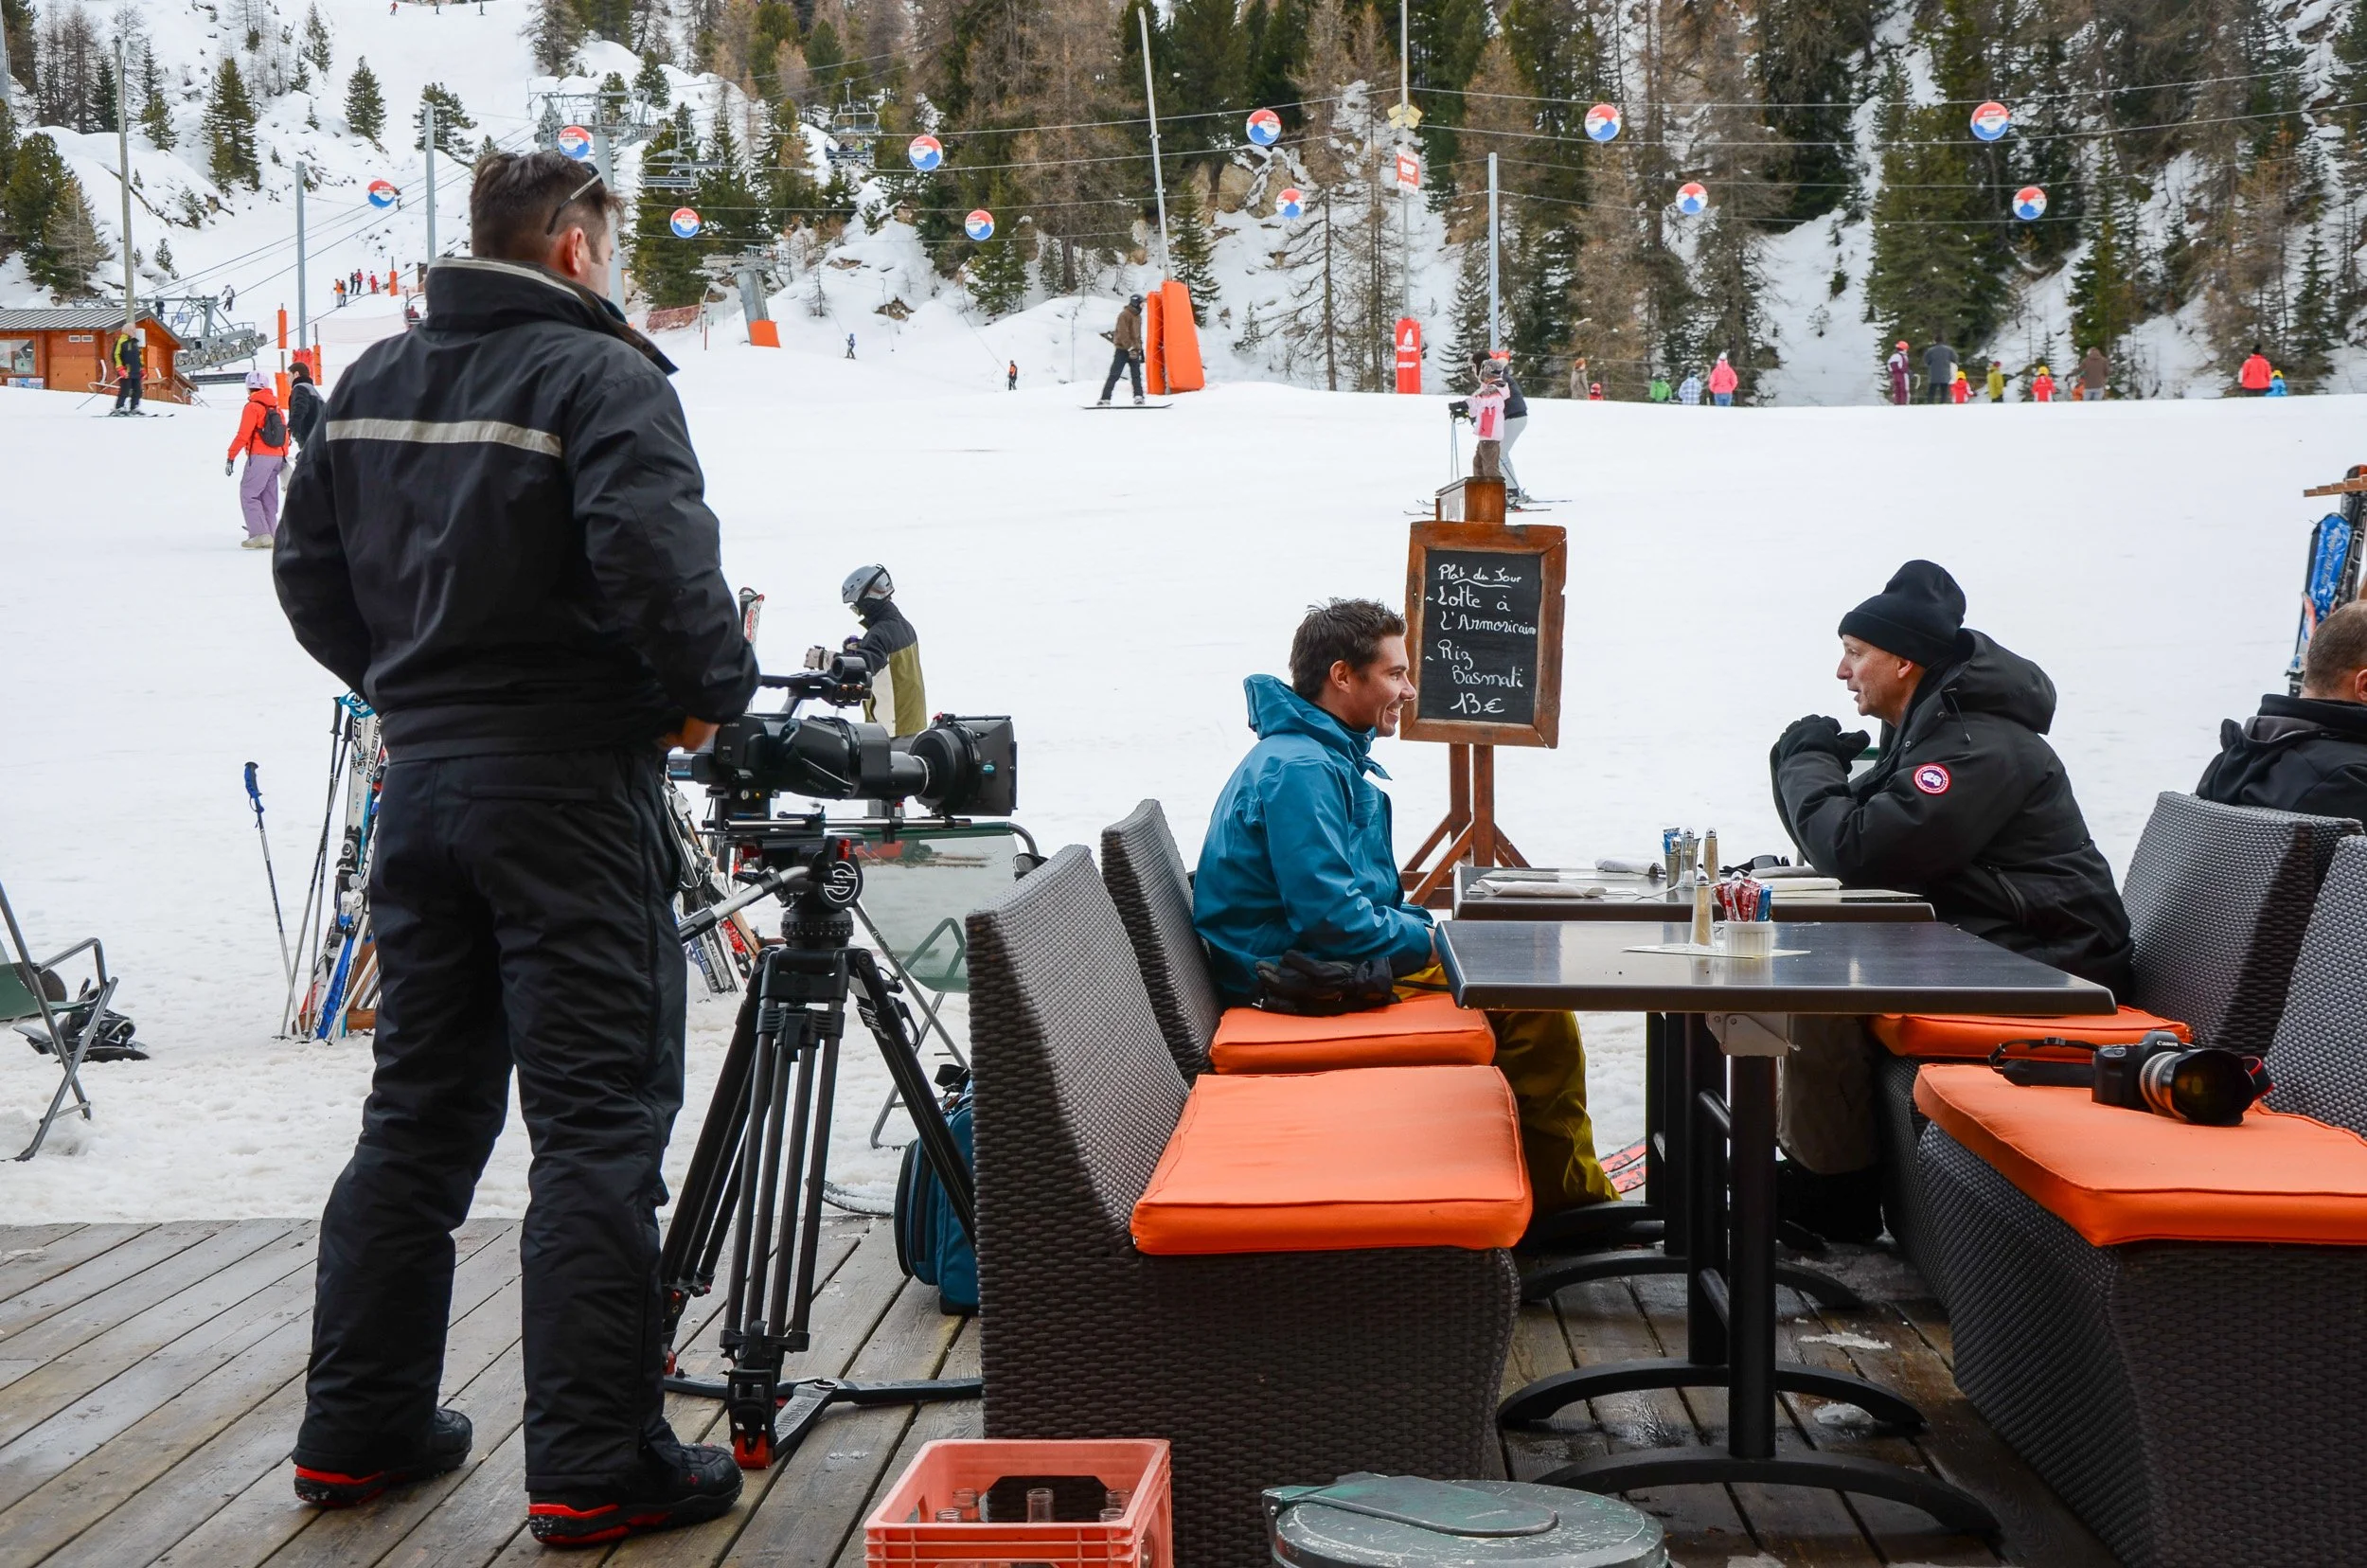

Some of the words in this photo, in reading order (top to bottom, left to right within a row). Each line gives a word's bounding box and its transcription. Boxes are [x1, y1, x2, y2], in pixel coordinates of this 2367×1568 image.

[1438, 563, 1465, 580] Plat
[1473, 567, 1489, 582] du
[1437, 586, 1481, 608] Lotte
[1497, 596, 1511, 611] à
[1437, 639, 1473, 670] Riz
[1452, 666, 1523, 687] Basmati
[1450, 692, 1504, 714] 13€
